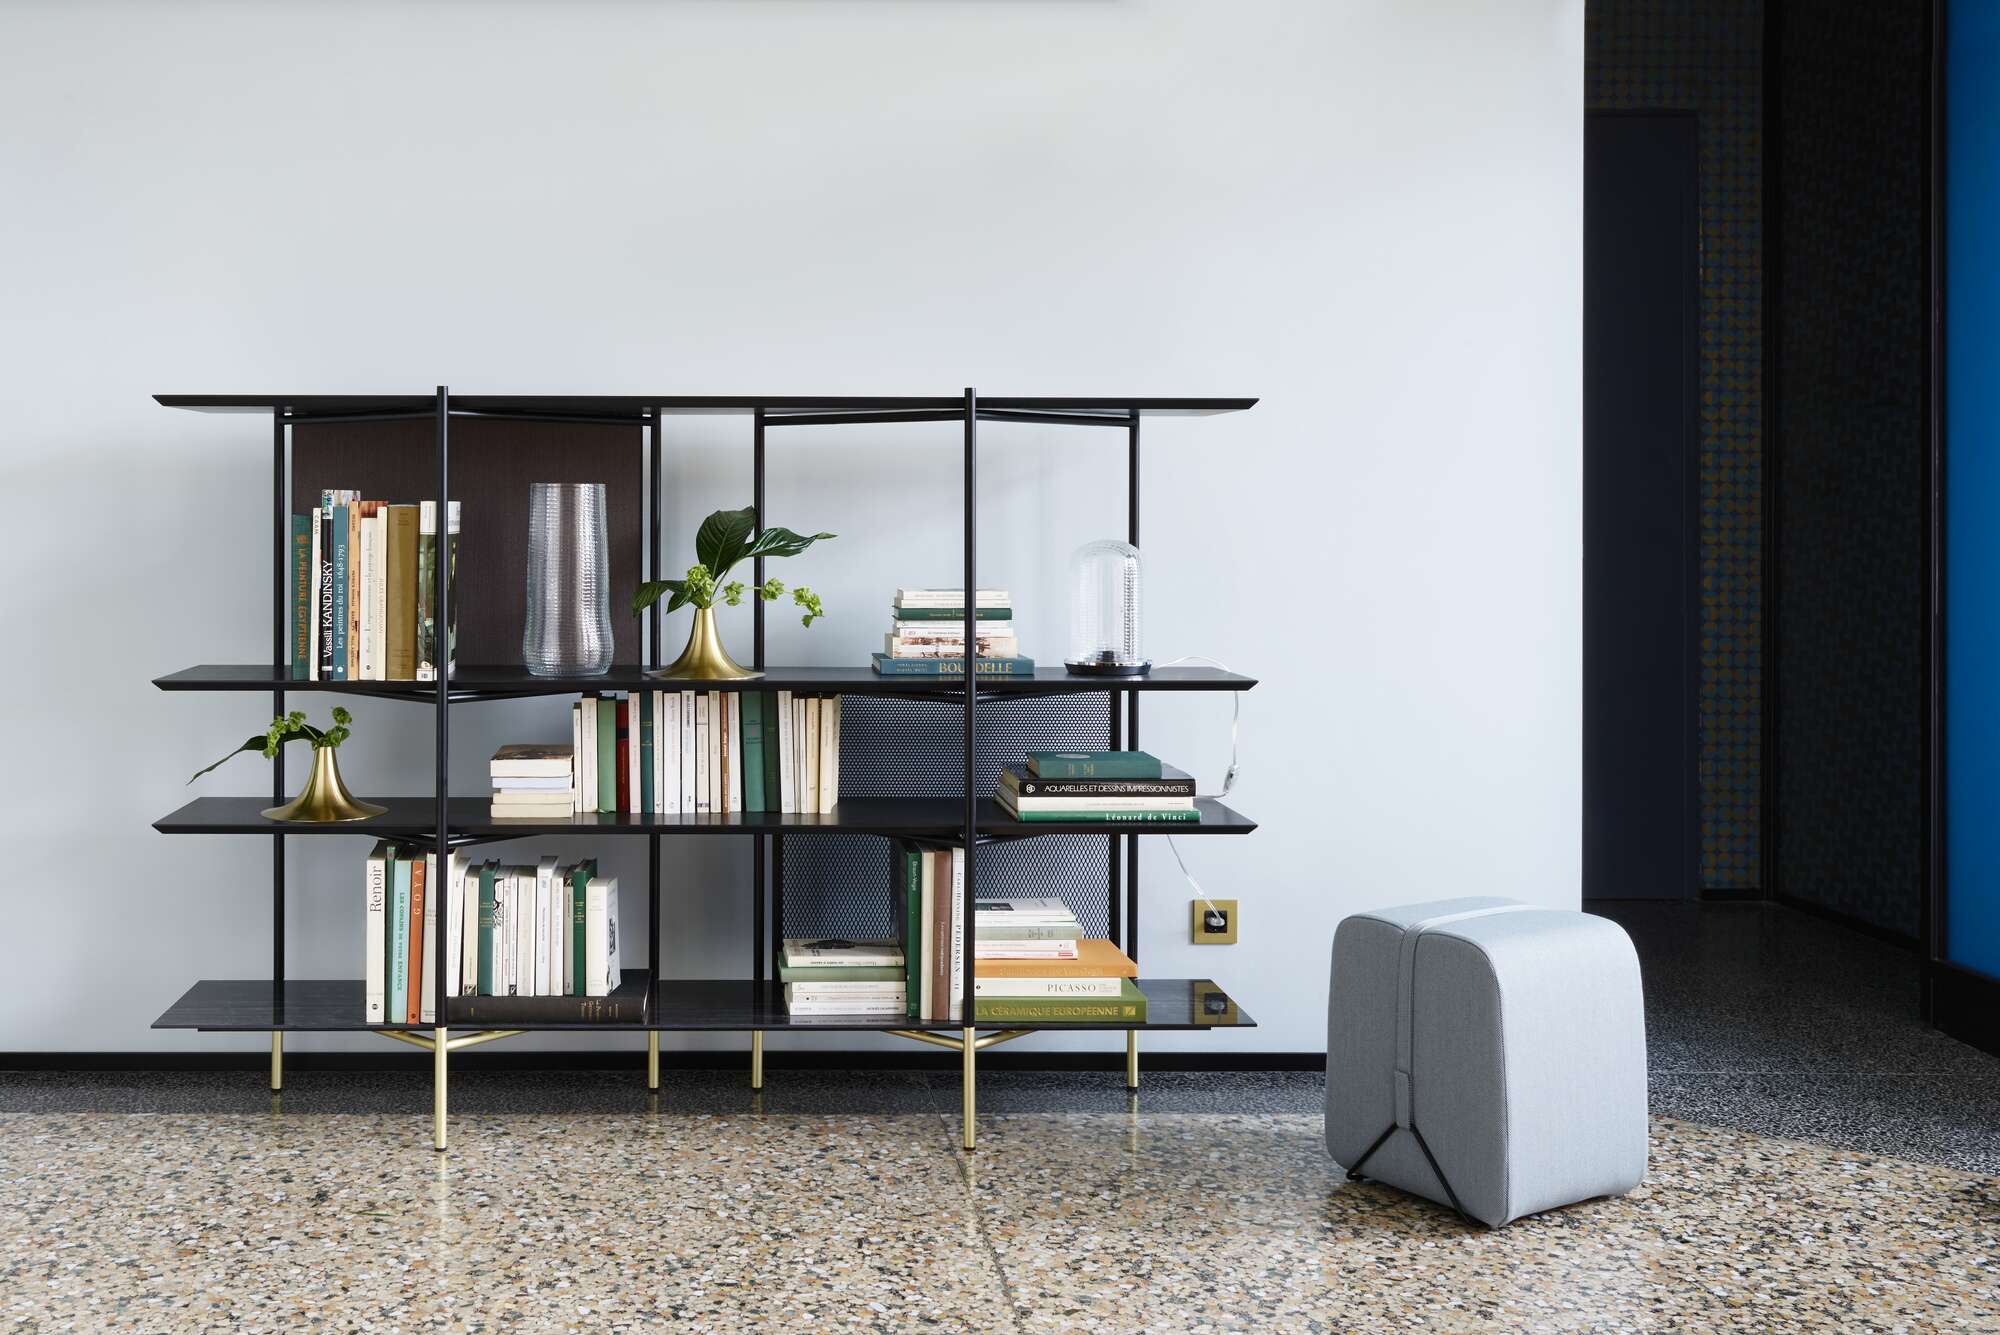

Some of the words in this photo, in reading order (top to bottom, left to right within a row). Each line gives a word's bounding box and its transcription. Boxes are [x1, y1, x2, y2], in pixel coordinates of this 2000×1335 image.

[336, 544, 345, 579] 1648-1793
[322, 559, 333, 627] KANDINSKY
[336, 583, 344, 594] roi
[336, 595, 344, 605] du
[336, 606, 345, 635] peintres
[323, 630, 333, 658] Vassili
[336, 637, 344, 649] Les
[939, 662, 1013, 673] BOUDELLE
[1044, 784, 1089, 793] AQUARELLES
[1089, 784, 1098, 793] ET
[1098, 784, 1127, 793] DESSINS
[1127, 784, 1189, 793] IMPRESSIONNISTES
[1106, 812, 1143, 821] Léonard
[1147, 812, 1158, 821] de
[1162, 812, 1187, 821] Vinci
[370, 865, 384, 913] Renoir
[1047, 984, 1096, 992] PICASSO
[976, 1007, 989, 1016] LA
